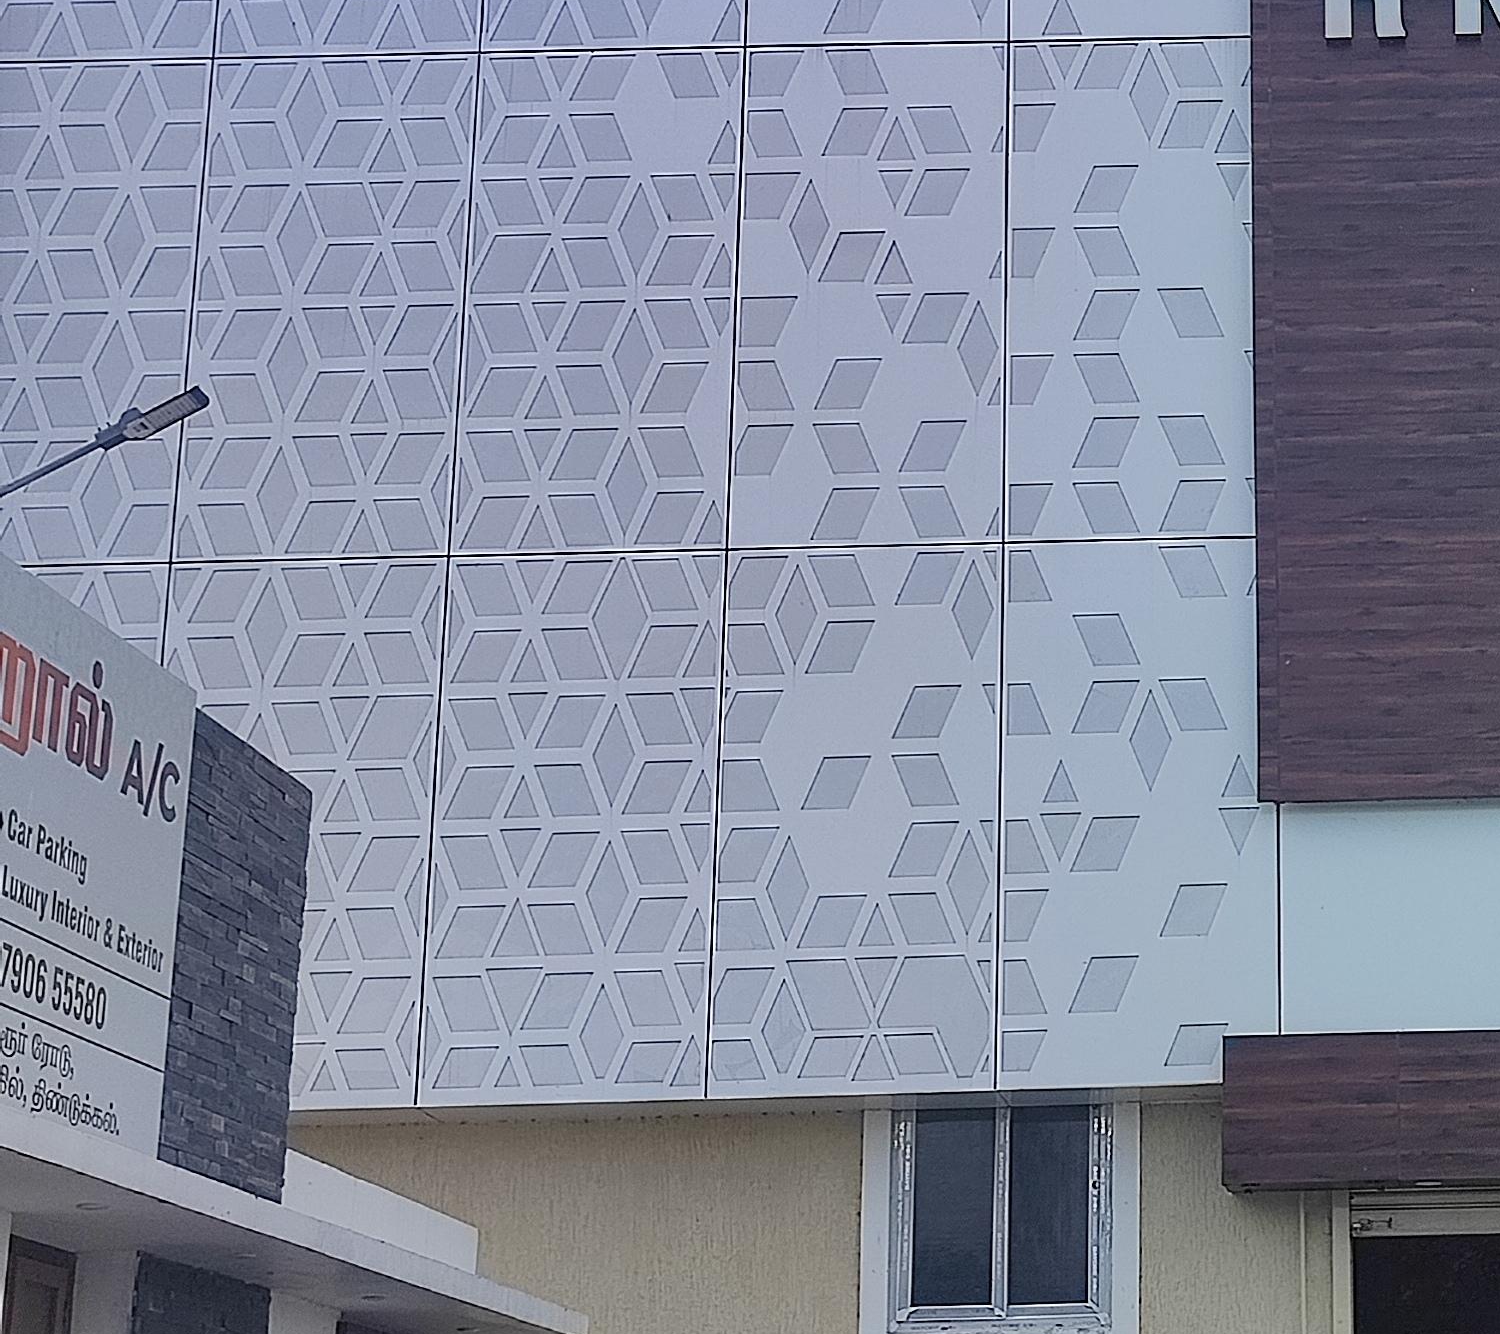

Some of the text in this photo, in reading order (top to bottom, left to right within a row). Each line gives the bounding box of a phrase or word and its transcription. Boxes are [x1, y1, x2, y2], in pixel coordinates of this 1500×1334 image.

[120, 739, 181, 822] A/C
[7, 809, 88, 885] Car Parking
[1, 864, 164, 973] Luxury Interior & Exterior
[0, 942, 107, 1030] 7906 55580
